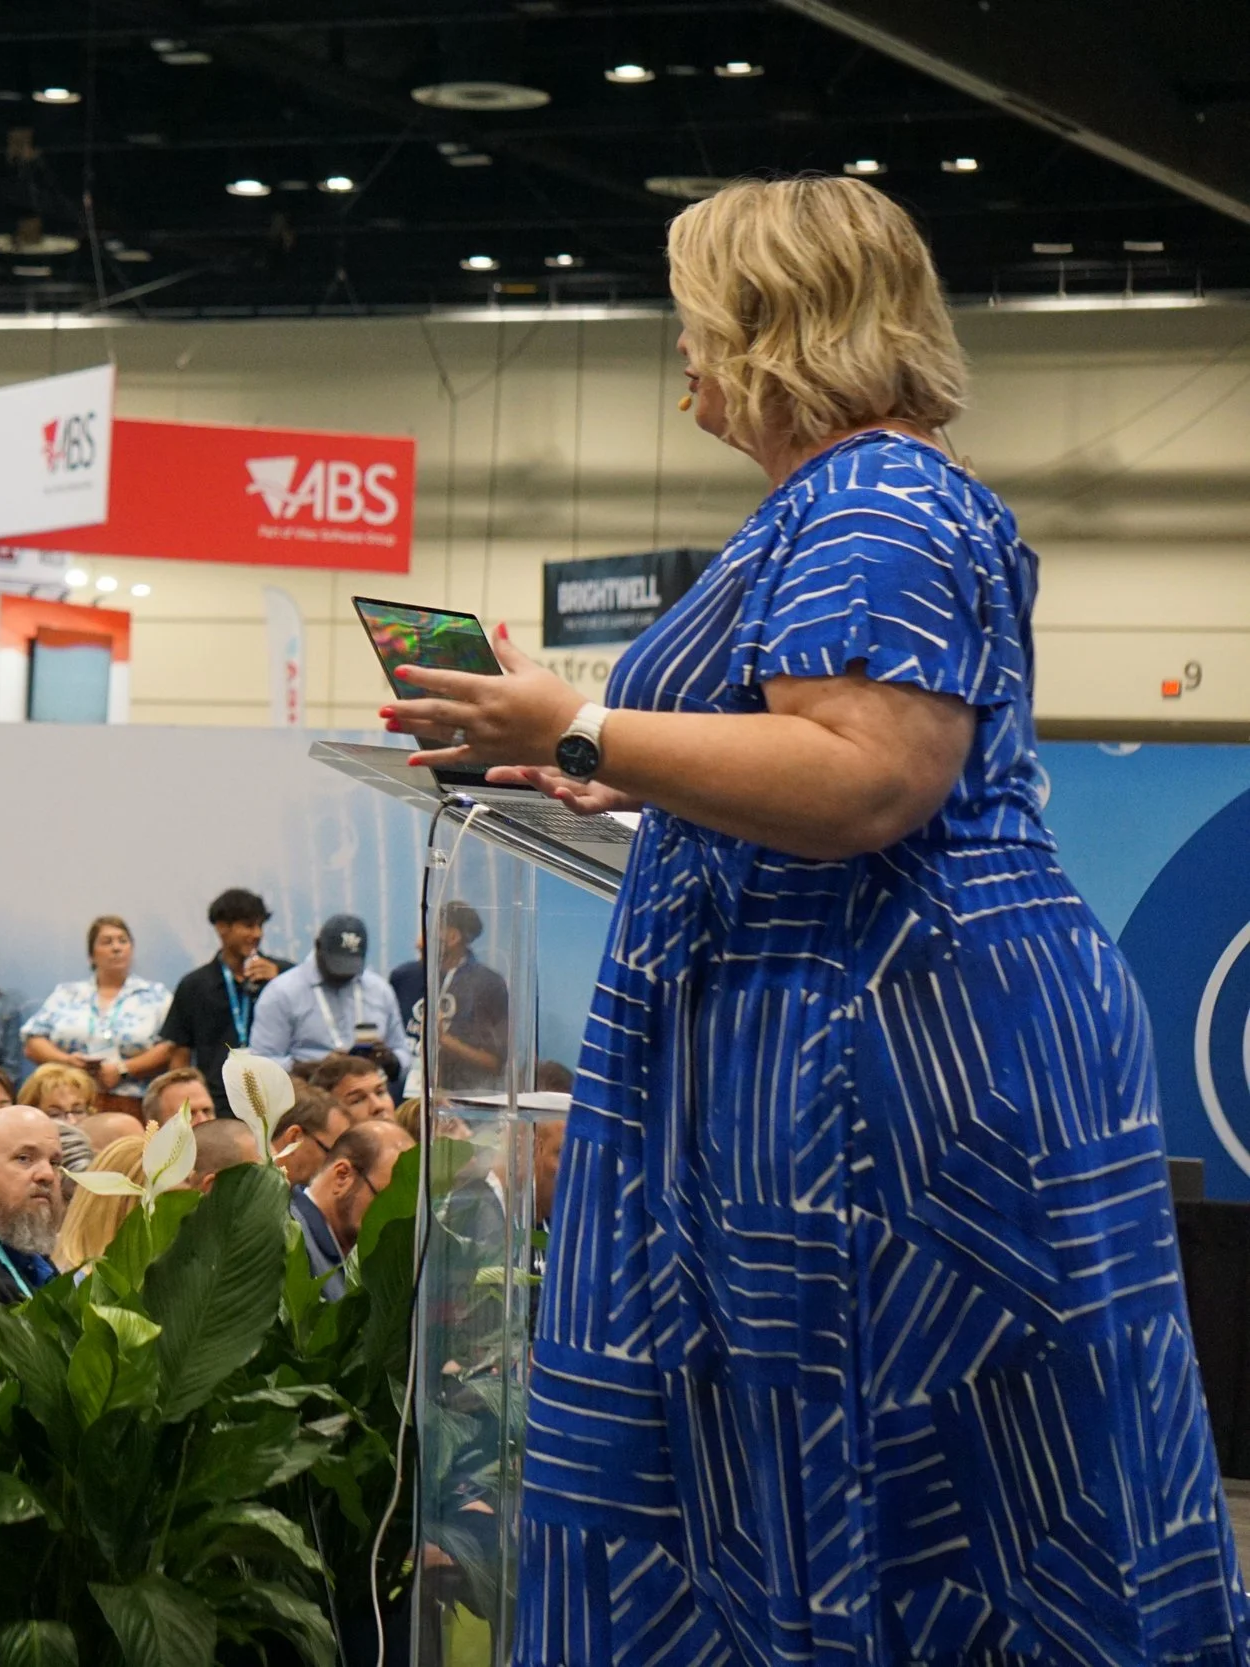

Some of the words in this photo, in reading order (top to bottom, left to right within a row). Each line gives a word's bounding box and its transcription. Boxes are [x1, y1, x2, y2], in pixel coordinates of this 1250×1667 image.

[282, 460, 399, 526] ABS
[557, 574, 662, 614] BRIGHTWELL
[1184, 660, 1202, 692] 9
